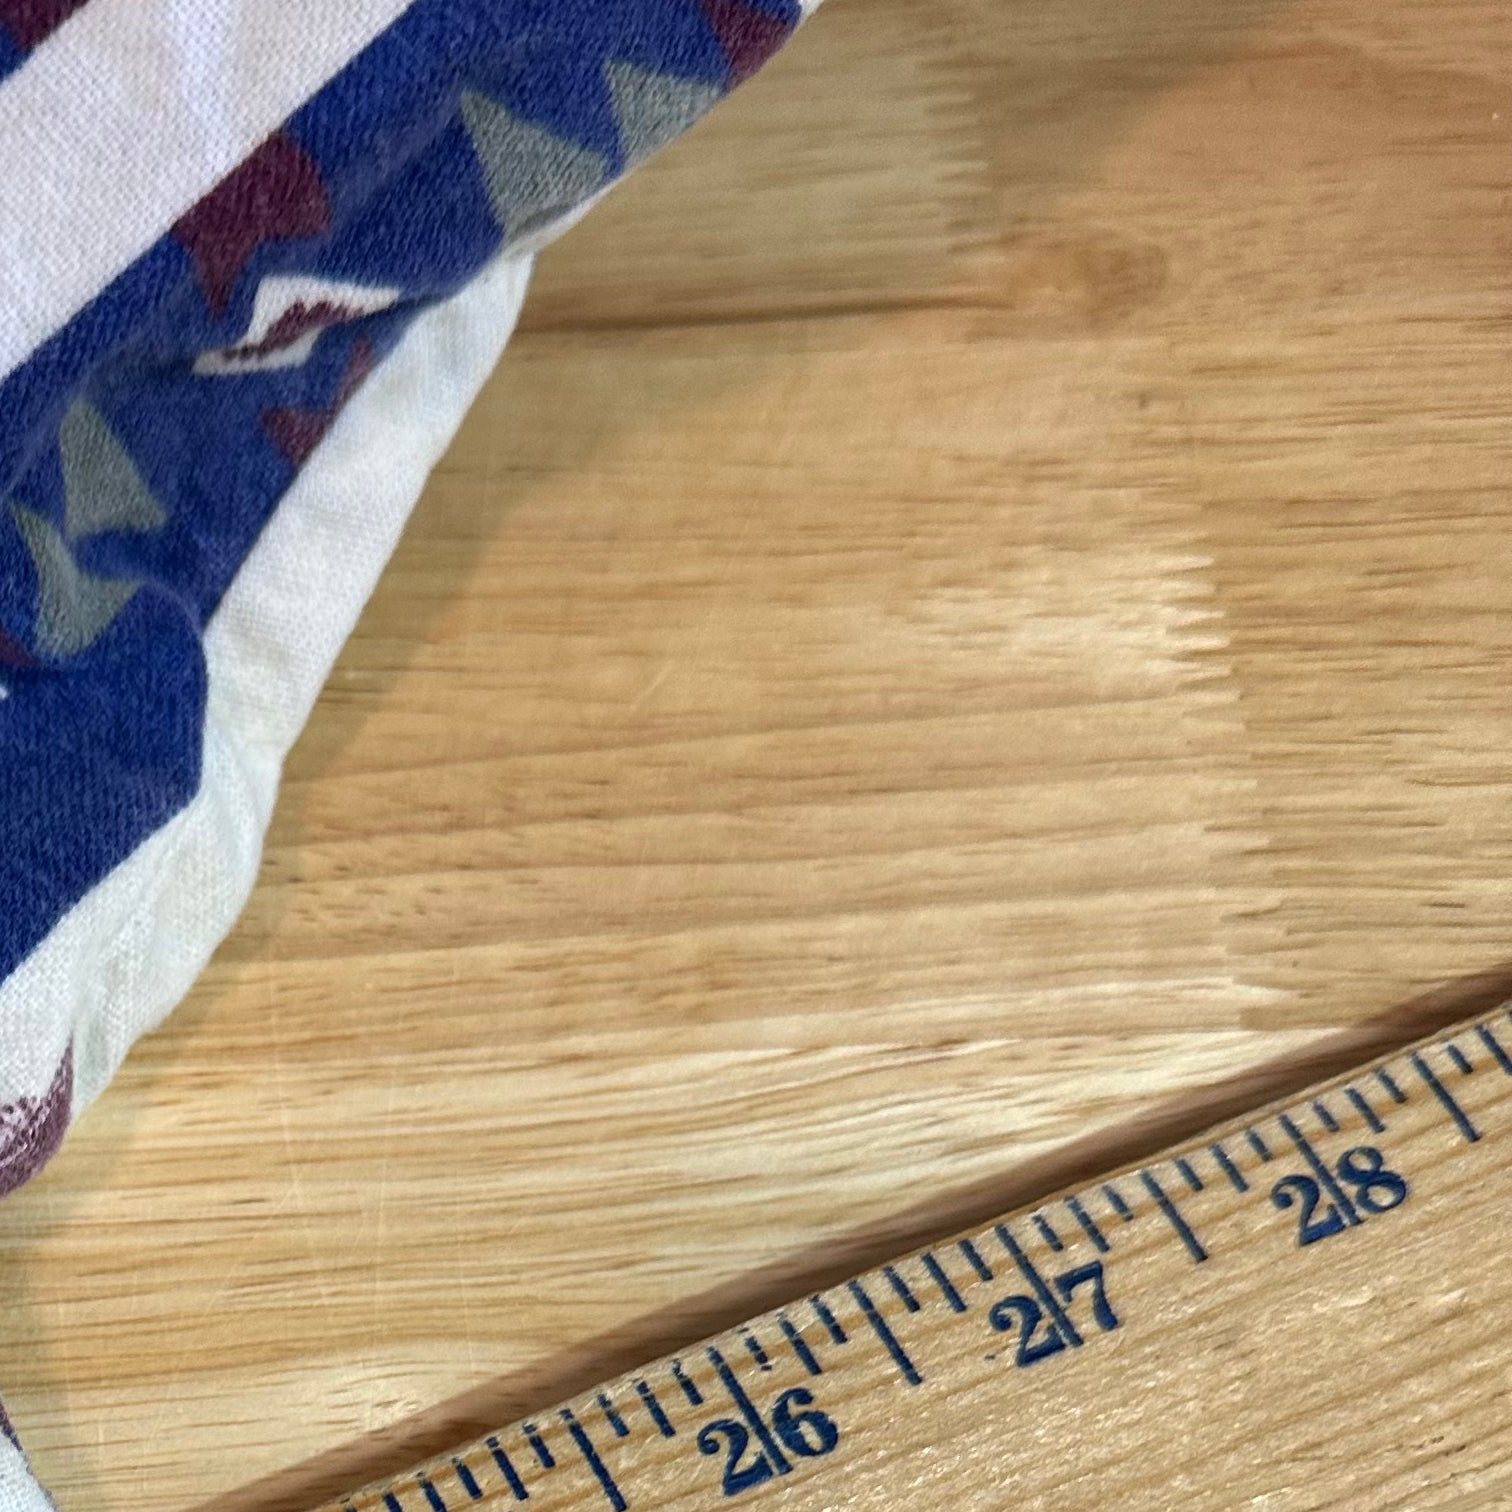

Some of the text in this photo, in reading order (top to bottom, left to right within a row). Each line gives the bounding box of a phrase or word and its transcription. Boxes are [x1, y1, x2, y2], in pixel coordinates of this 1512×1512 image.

[697, 1388, 839, 1496] 26
[989, 1262, 1121, 1367] 27
[1271, 1146, 1408, 1247] 28
